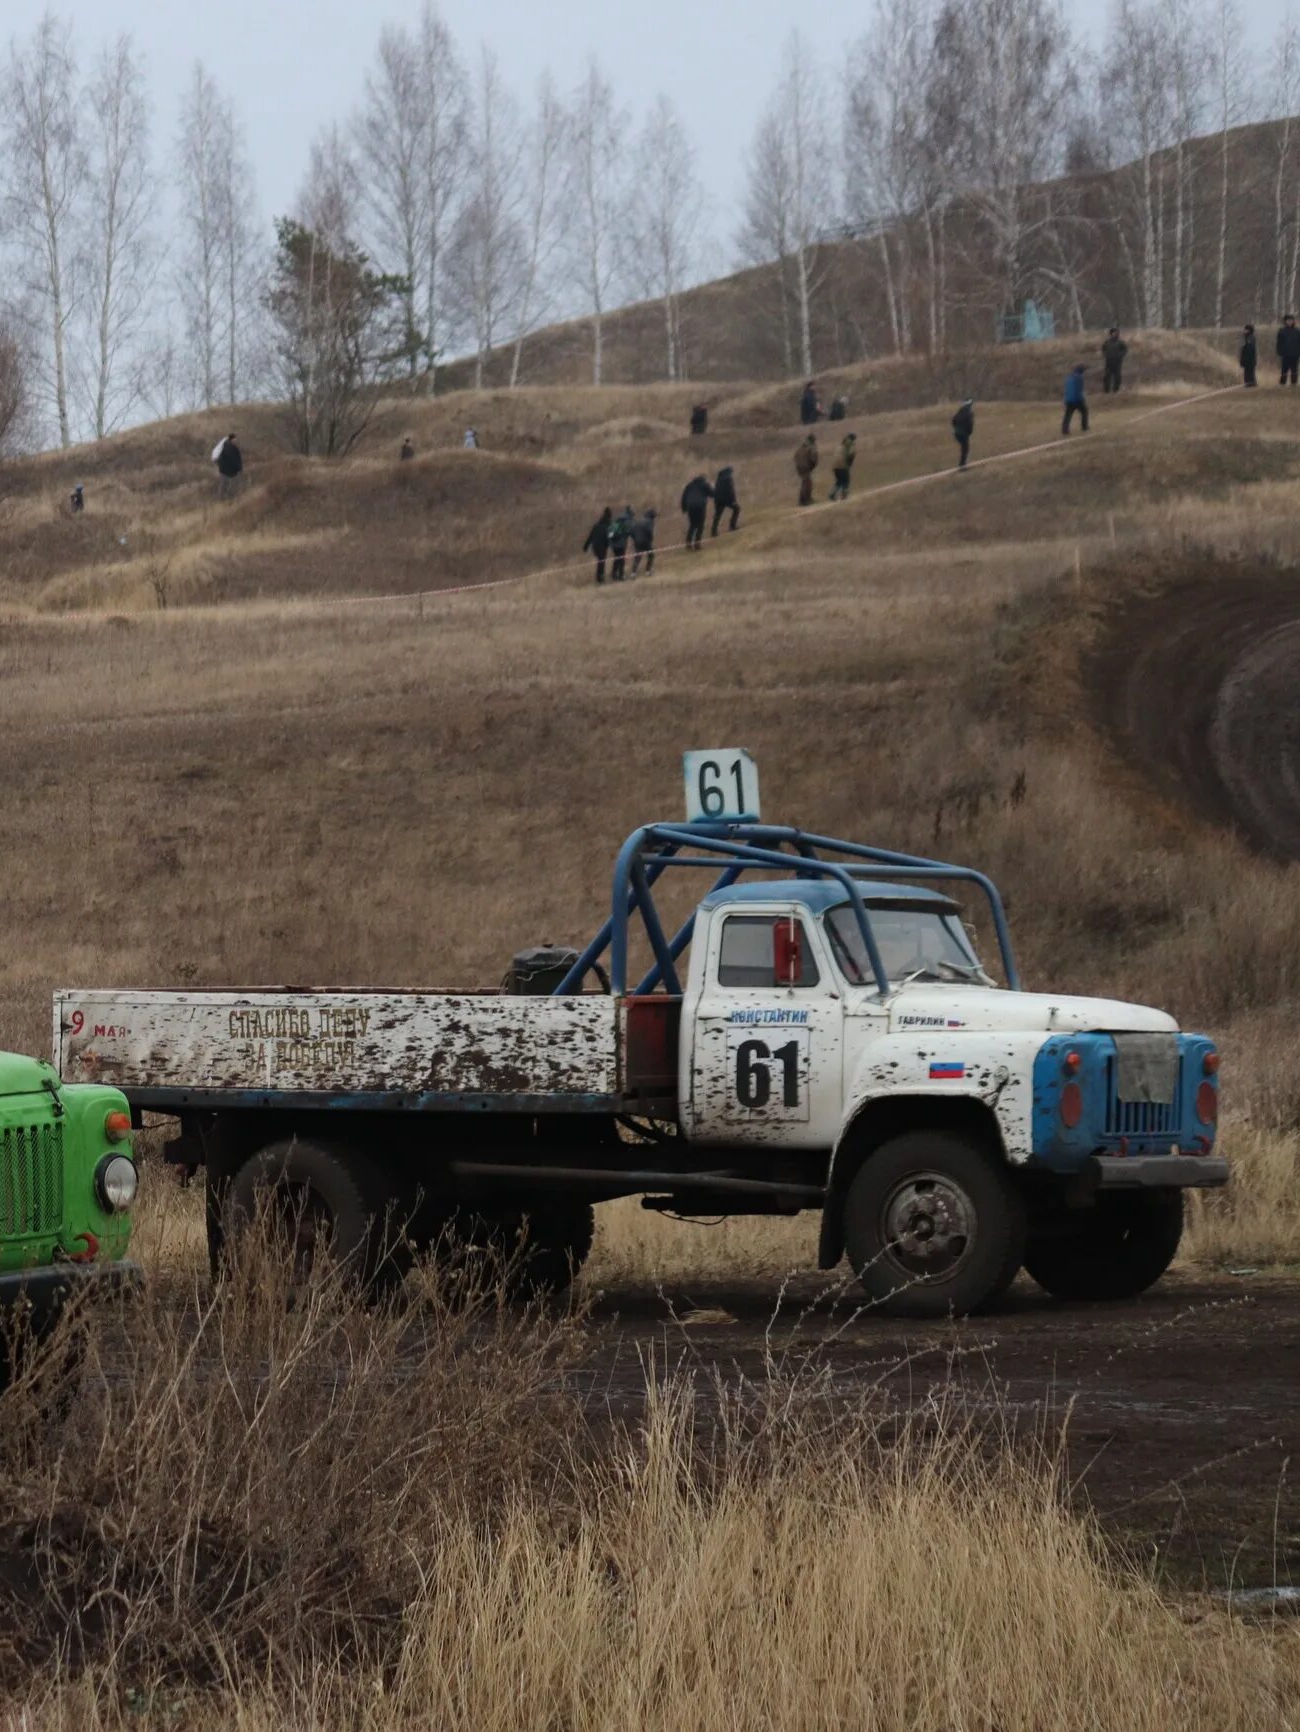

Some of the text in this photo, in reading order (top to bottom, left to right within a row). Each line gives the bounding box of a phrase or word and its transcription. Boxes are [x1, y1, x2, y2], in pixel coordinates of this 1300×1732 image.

[698, 758, 745, 818] 61
[71, 1010, 126, 1038] 9 МАЯ
[228, 1007, 371, 1040] СПАСИБО ДЕДУ
[730, 1009, 809, 1024] КОНСТАНТИН
[245, 1041, 267, 1074] ЗА
[736, 1039, 799, 1108] 61
